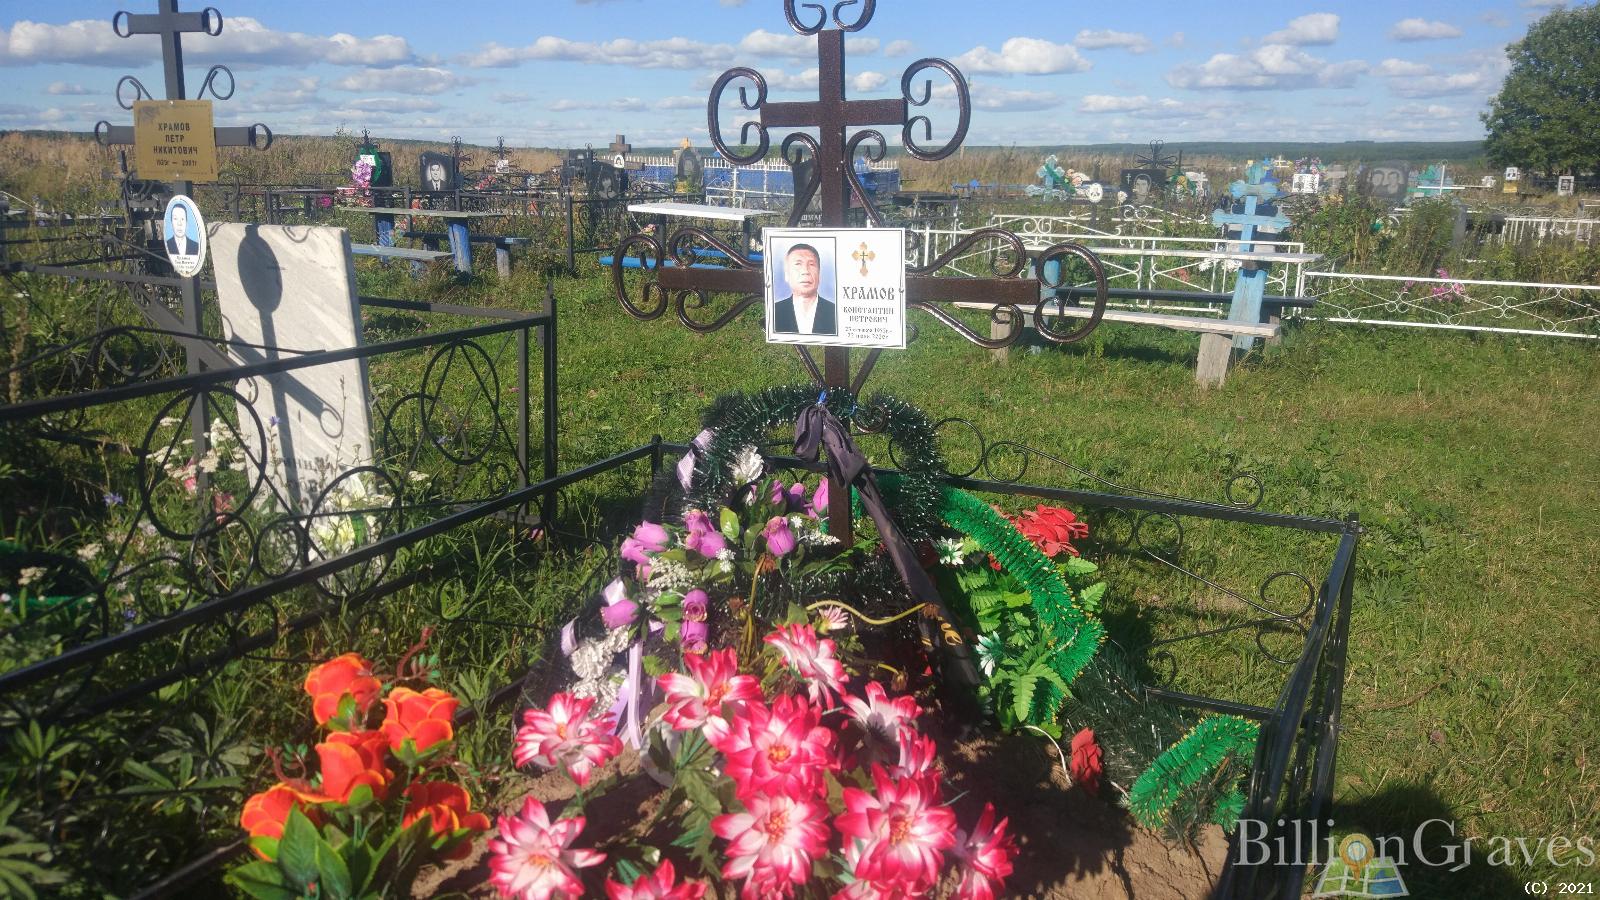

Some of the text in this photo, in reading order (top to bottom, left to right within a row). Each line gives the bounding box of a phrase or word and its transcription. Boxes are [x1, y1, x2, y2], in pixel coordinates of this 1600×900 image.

[158, 122, 191, 131] ХРАМОВ
[165, 134, 185, 143] ПЕТР
[153, 145, 198, 155] НИКИТОВИЧ
[842, 286, 895, 300] ХРАМОВ
[843, 306, 894, 315] КОНСТАНТИН
[849, 315, 888, 324] ПЕТРОВИЧ
